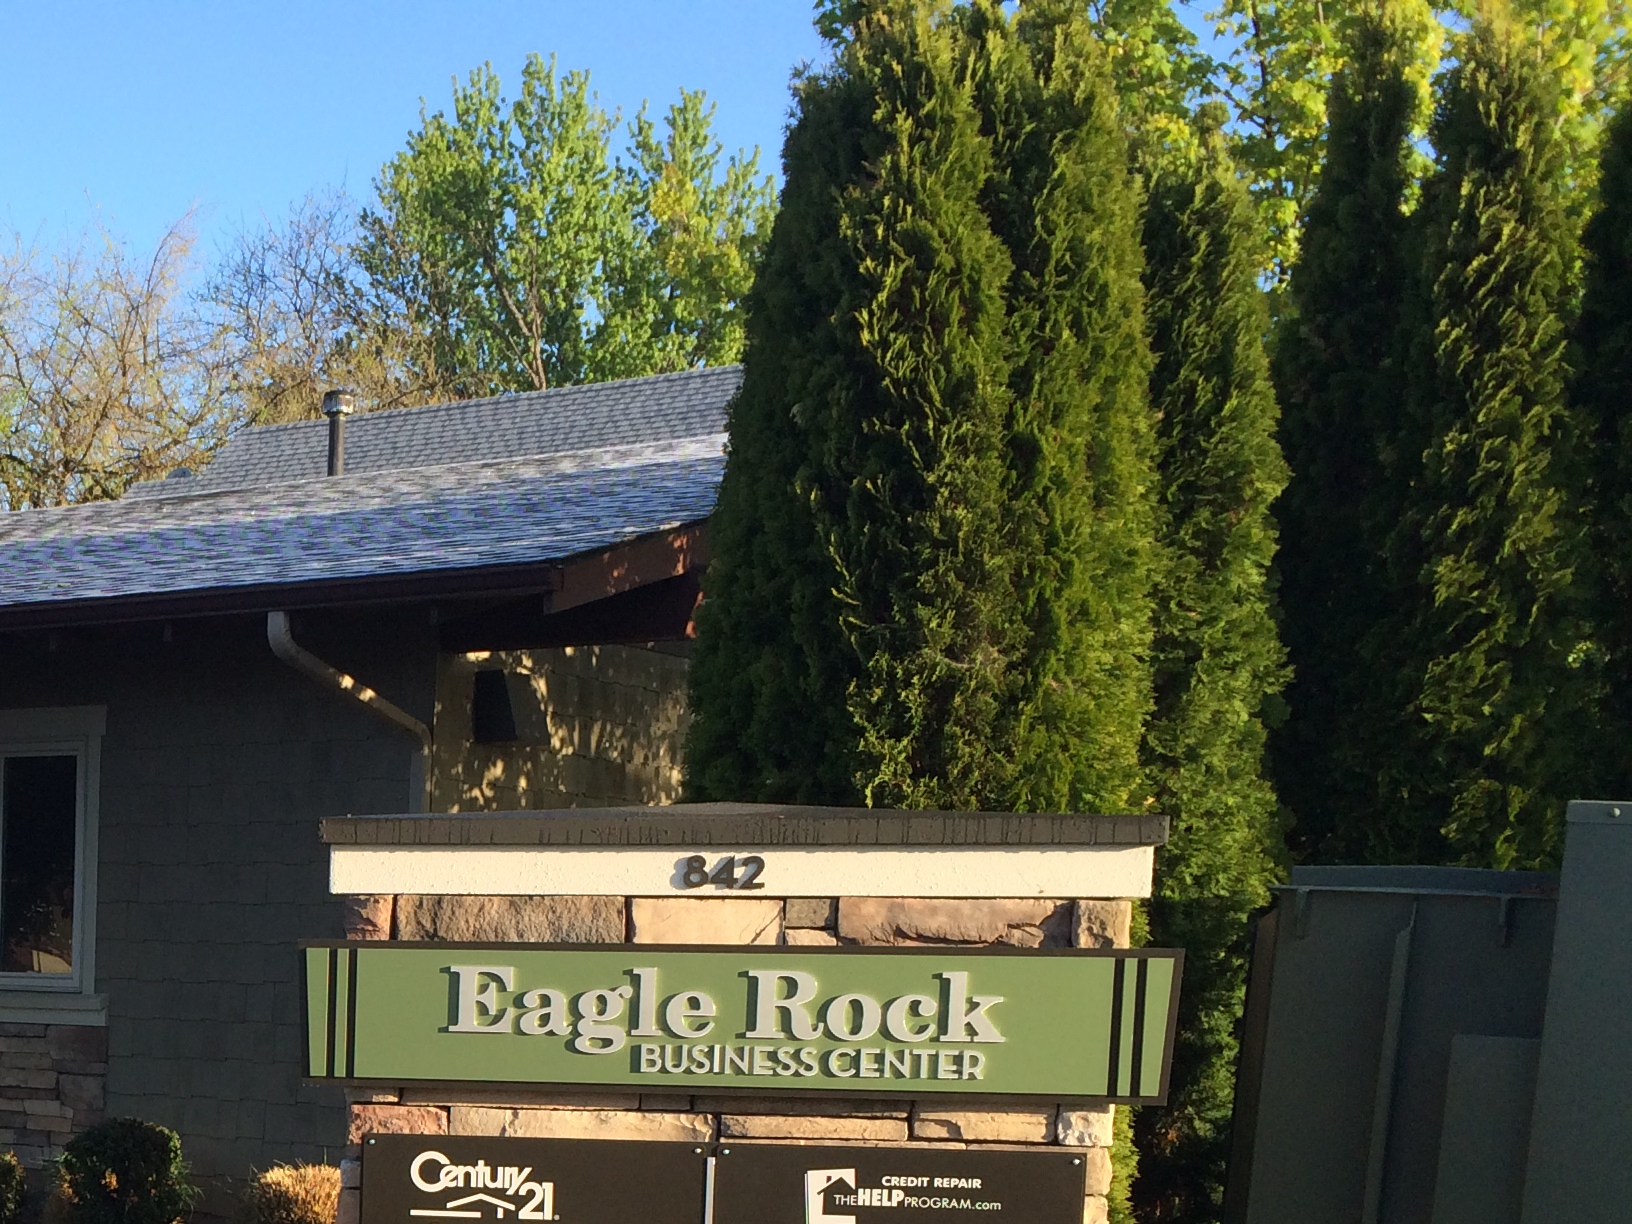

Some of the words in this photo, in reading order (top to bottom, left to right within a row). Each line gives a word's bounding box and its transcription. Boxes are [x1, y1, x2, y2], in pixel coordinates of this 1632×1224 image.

[684, 855, 765, 889] 842
[447, 964, 717, 1054] Eagle
[745, 969, 1006, 1044] Rock
[640, 1044, 818, 1076] BUSINESS
[828, 1048, 985, 1080] CENTER
[410, 1150, 532, 1195] Century
[881, 1176, 930, 1188] CREDIT
[933, 1177, 982, 1189] REPAIR
[518, 1181, 555, 1221] 21
